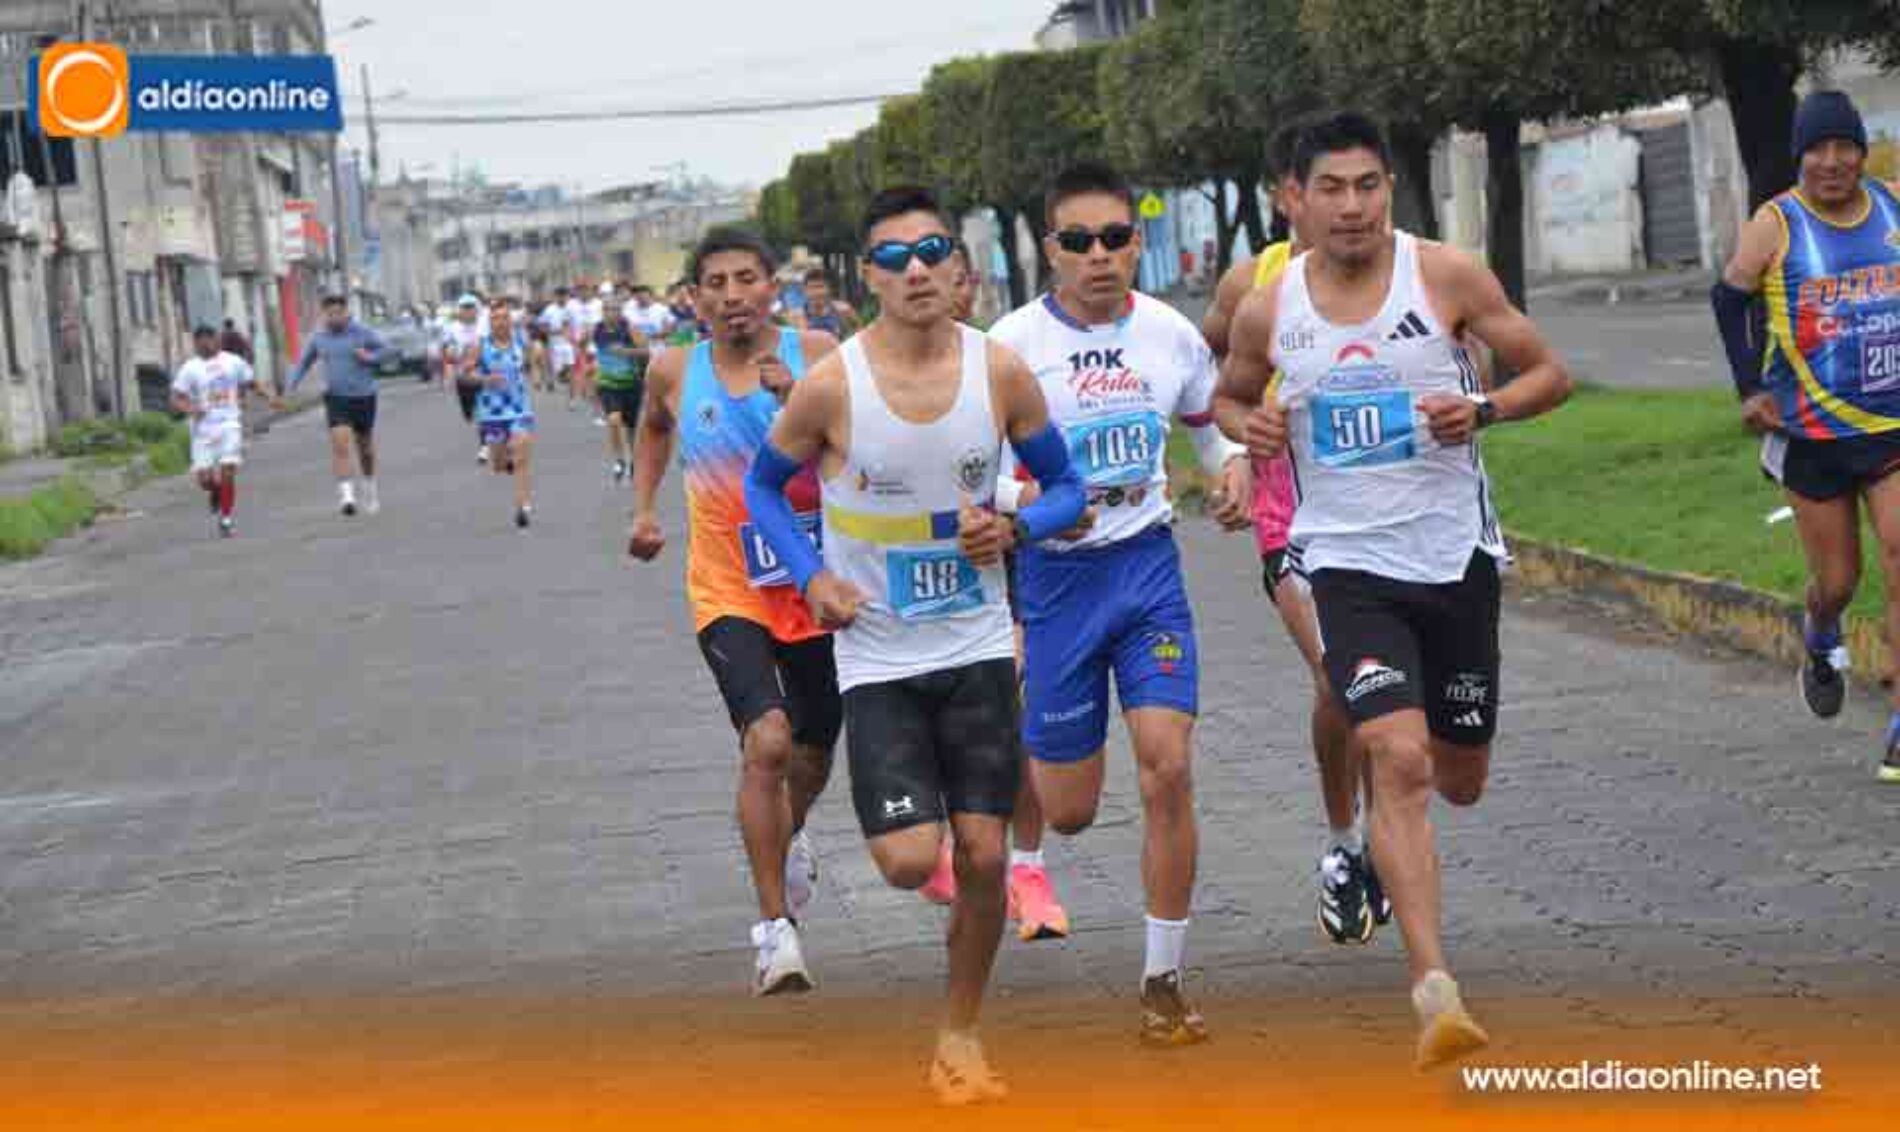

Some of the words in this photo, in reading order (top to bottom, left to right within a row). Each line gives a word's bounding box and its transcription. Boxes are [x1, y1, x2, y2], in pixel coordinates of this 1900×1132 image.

[1067, 348, 1125, 371] 10K
[1867, 345, 1900, 377] 20
[1088, 423, 1149, 470] 103
[1331, 404, 1381, 449] 50
[914, 558, 958, 599] 98
